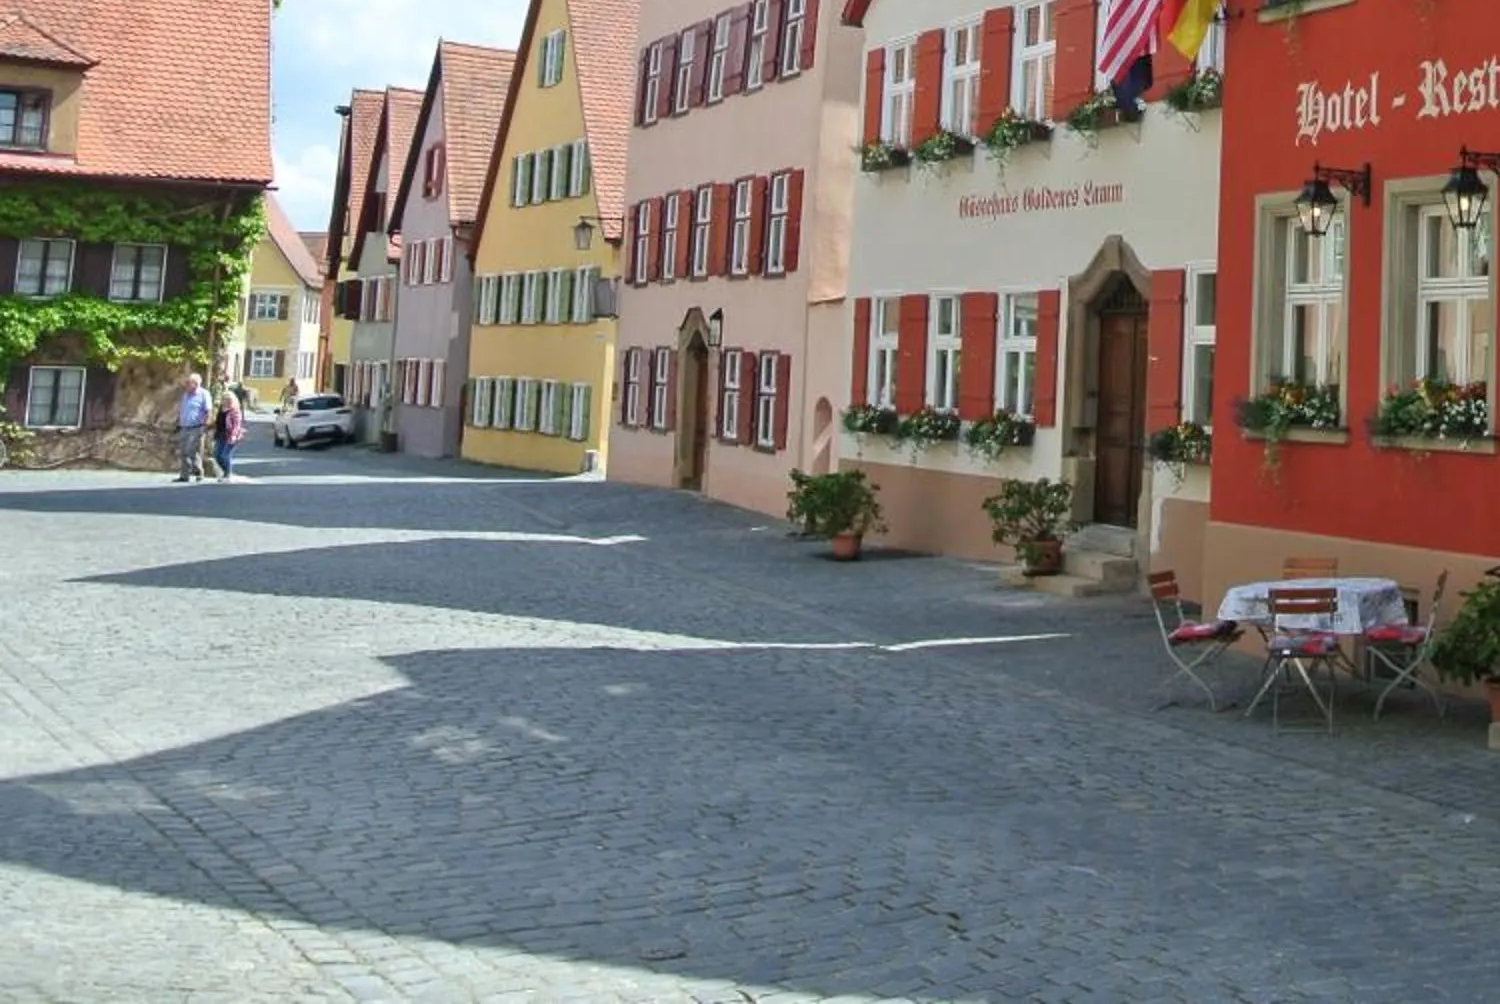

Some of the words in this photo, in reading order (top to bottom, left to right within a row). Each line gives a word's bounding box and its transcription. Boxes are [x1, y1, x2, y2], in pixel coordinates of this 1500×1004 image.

[1295, 71, 1381, 147] Hotel
[1023, 186, 1079, 211] Goldenes
[1083, 180, 1123, 206] Lamm
